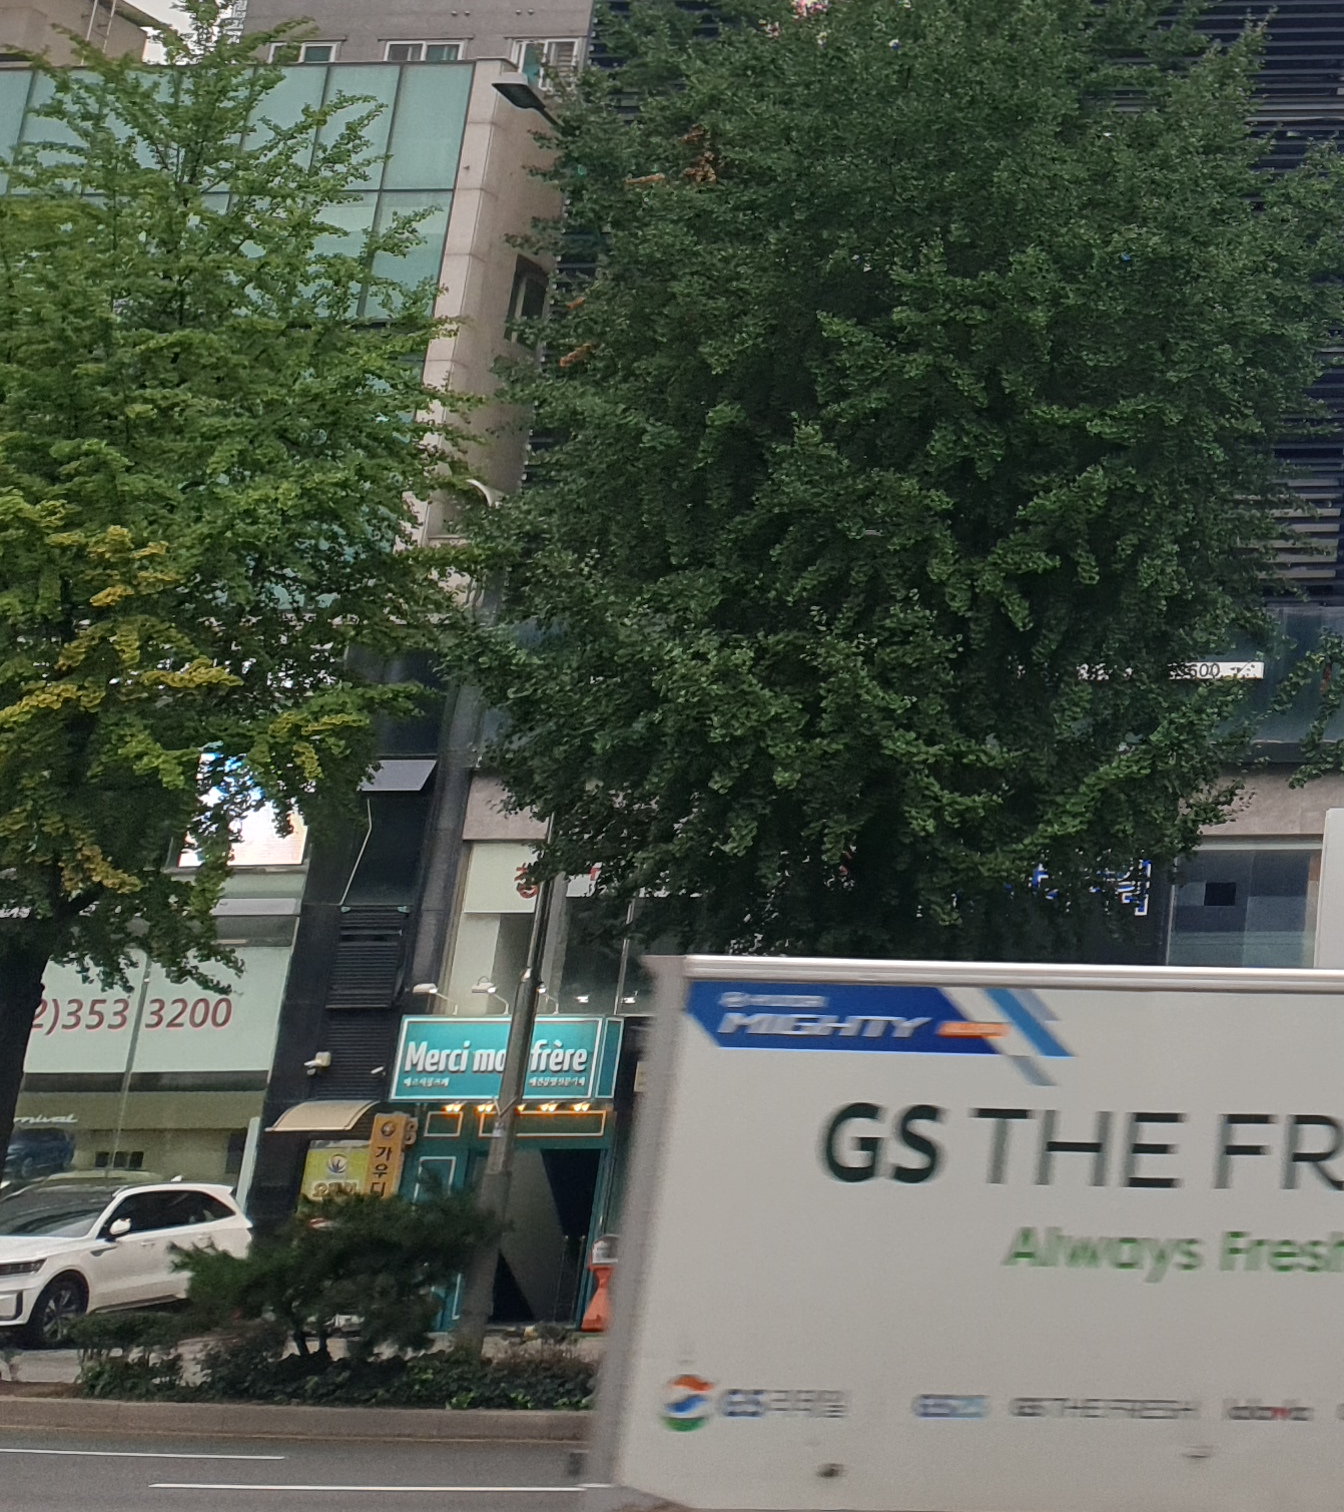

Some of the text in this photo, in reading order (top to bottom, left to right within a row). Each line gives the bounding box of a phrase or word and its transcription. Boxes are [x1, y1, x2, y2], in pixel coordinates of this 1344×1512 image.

[405, 1040, 471, 1073] Merci
[530, 1039, 588, 1073] frère
[821, 1102, 945, 1185] GS
[970, 1107, 1190, 1190] THE
[1004, 1226, 1204, 1285] Always
